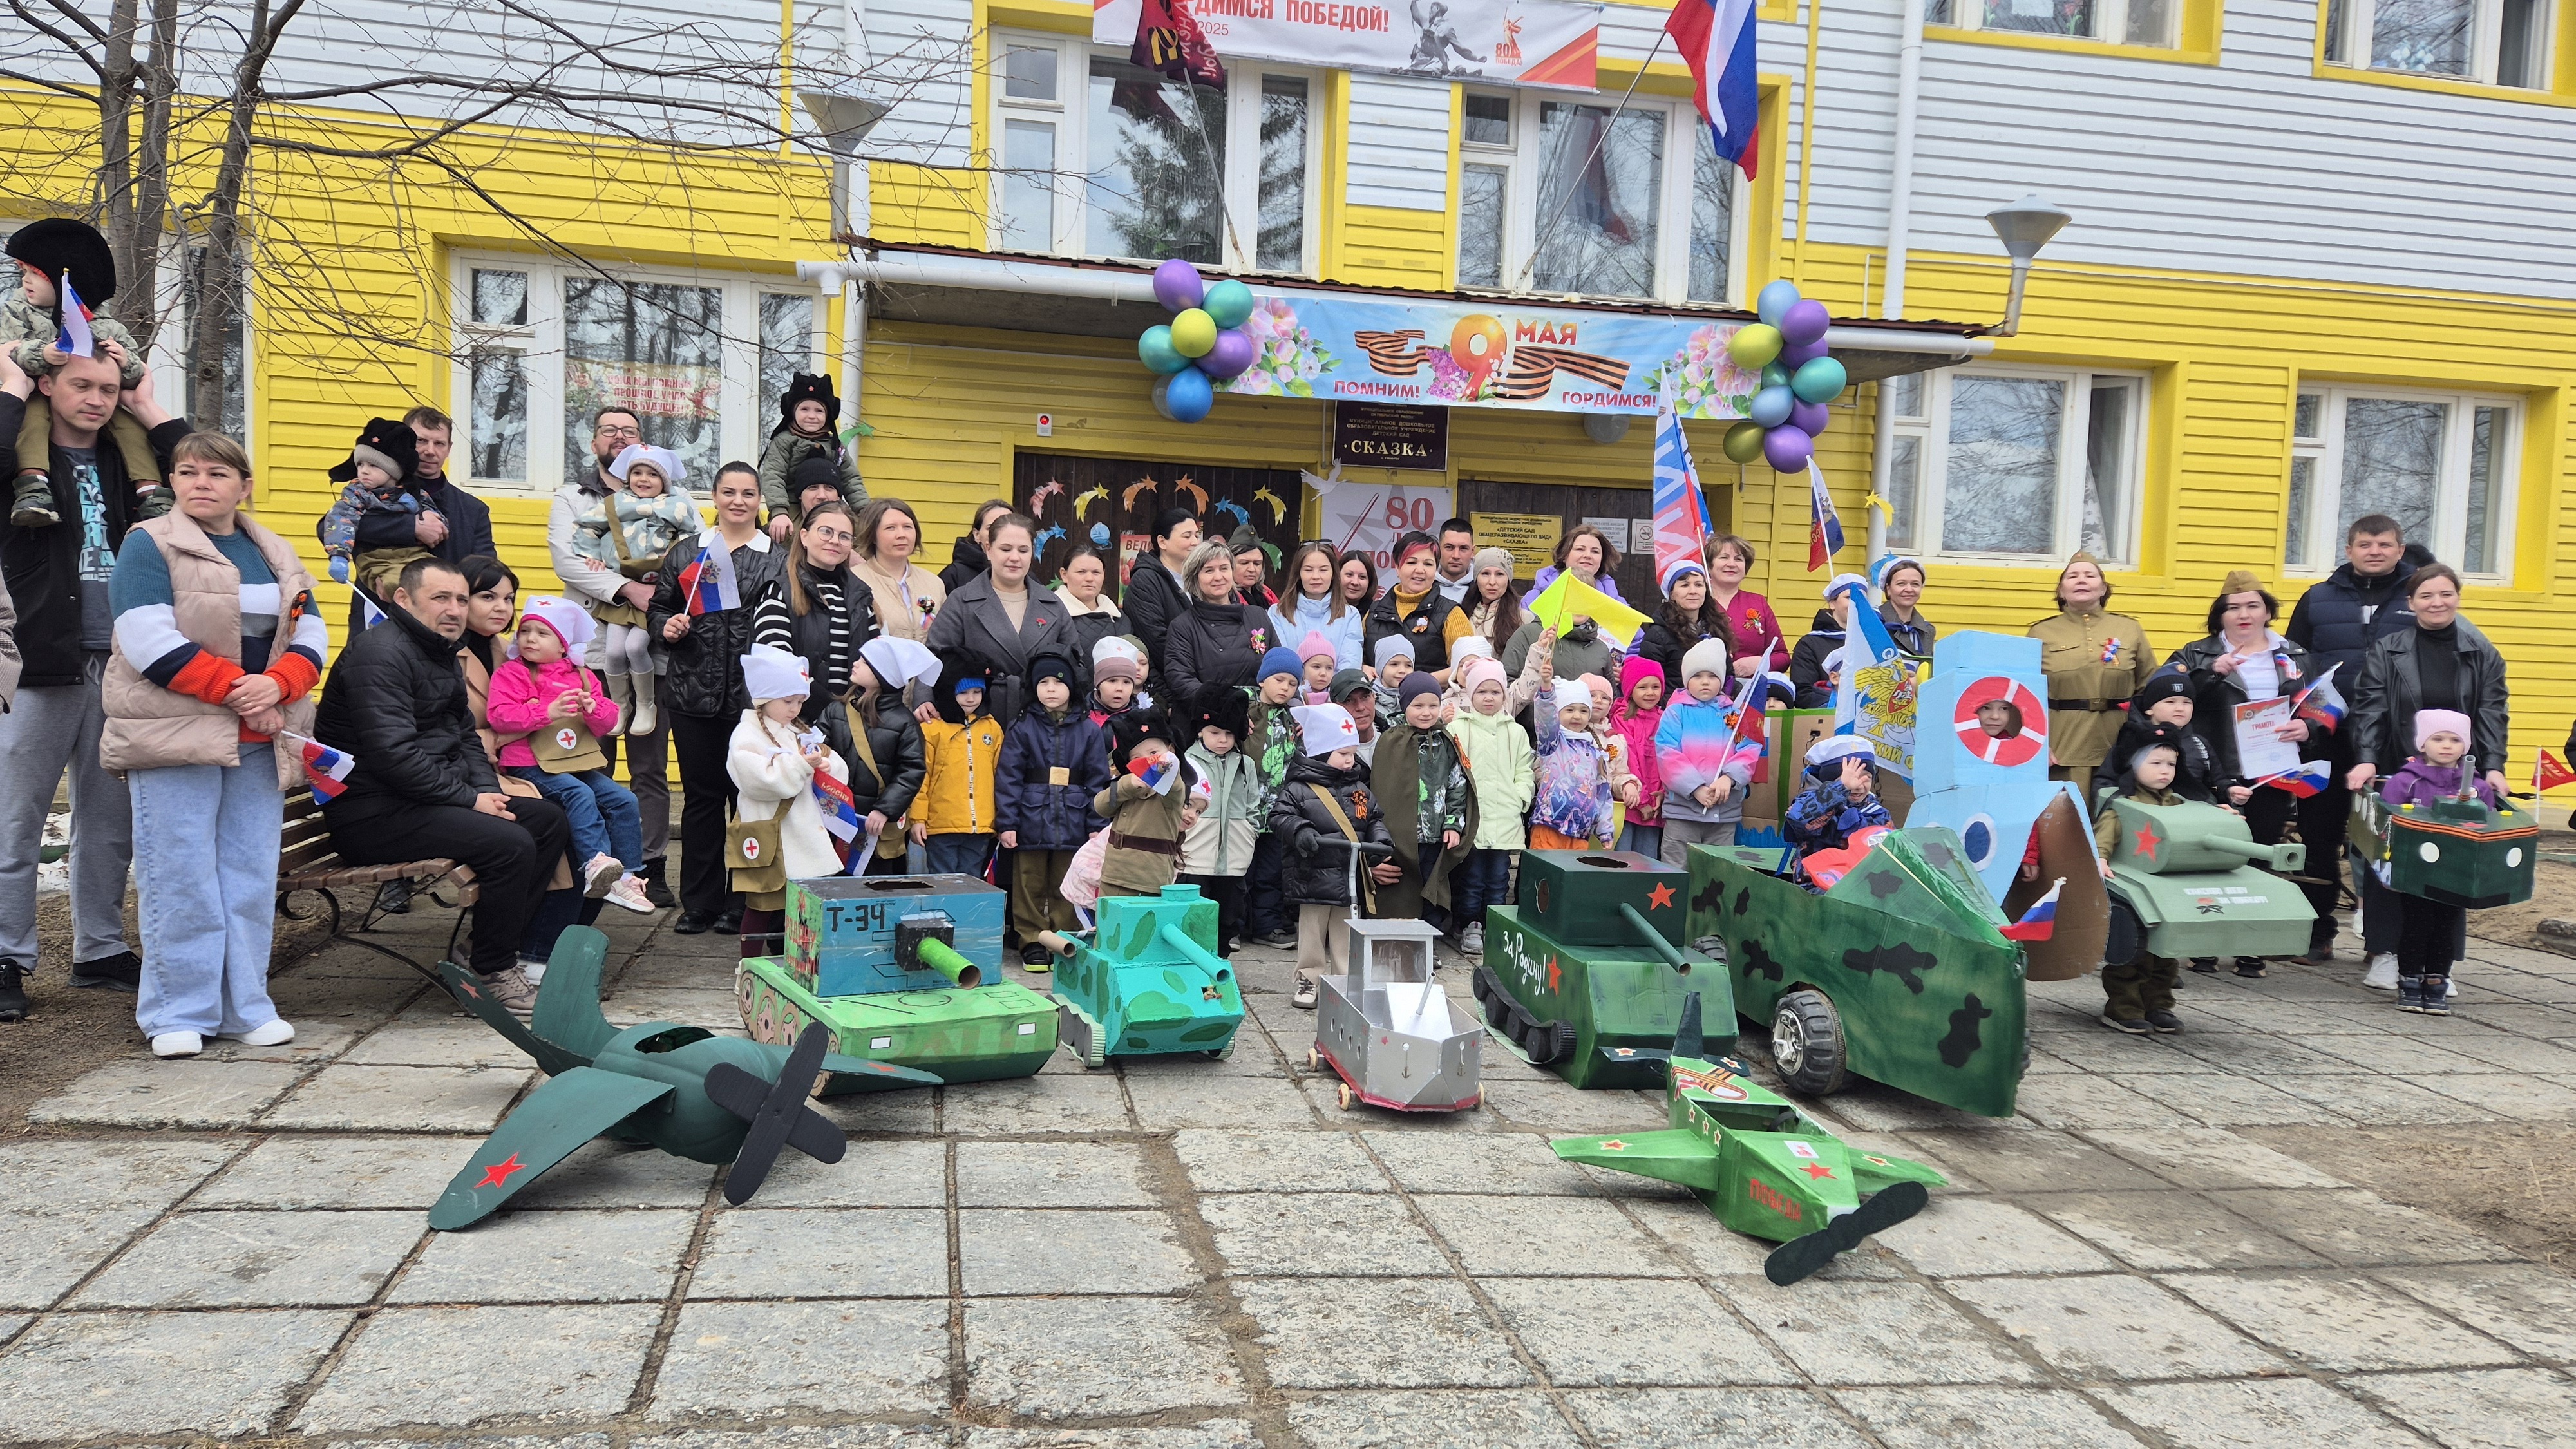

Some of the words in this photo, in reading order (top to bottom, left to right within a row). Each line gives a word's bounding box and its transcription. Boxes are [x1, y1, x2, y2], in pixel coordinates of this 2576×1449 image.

[1195, 0, 1273, 19] ДИМСЯ
[1286, 0, 1389, 32] ПОБЕДОЙ!
[1495, 43, 1510, 57] 80
[1450, 314, 1508, 402] 9
[1515, 319, 1578, 345] МАЯ
[1334, 380, 1420, 398] ПОМНИМ!
[1562, 391, 1657, 408] ГОРДИМСЯ!
[1385, 497, 1434, 531] 80
[2252, 720, 2275, 730] ГРАМОТА
[1503, 931, 1514, 958] За
[1513, 932, 1546, 996] Родину!
[1750, 1178, 1801, 1223] ПОБЕДА
